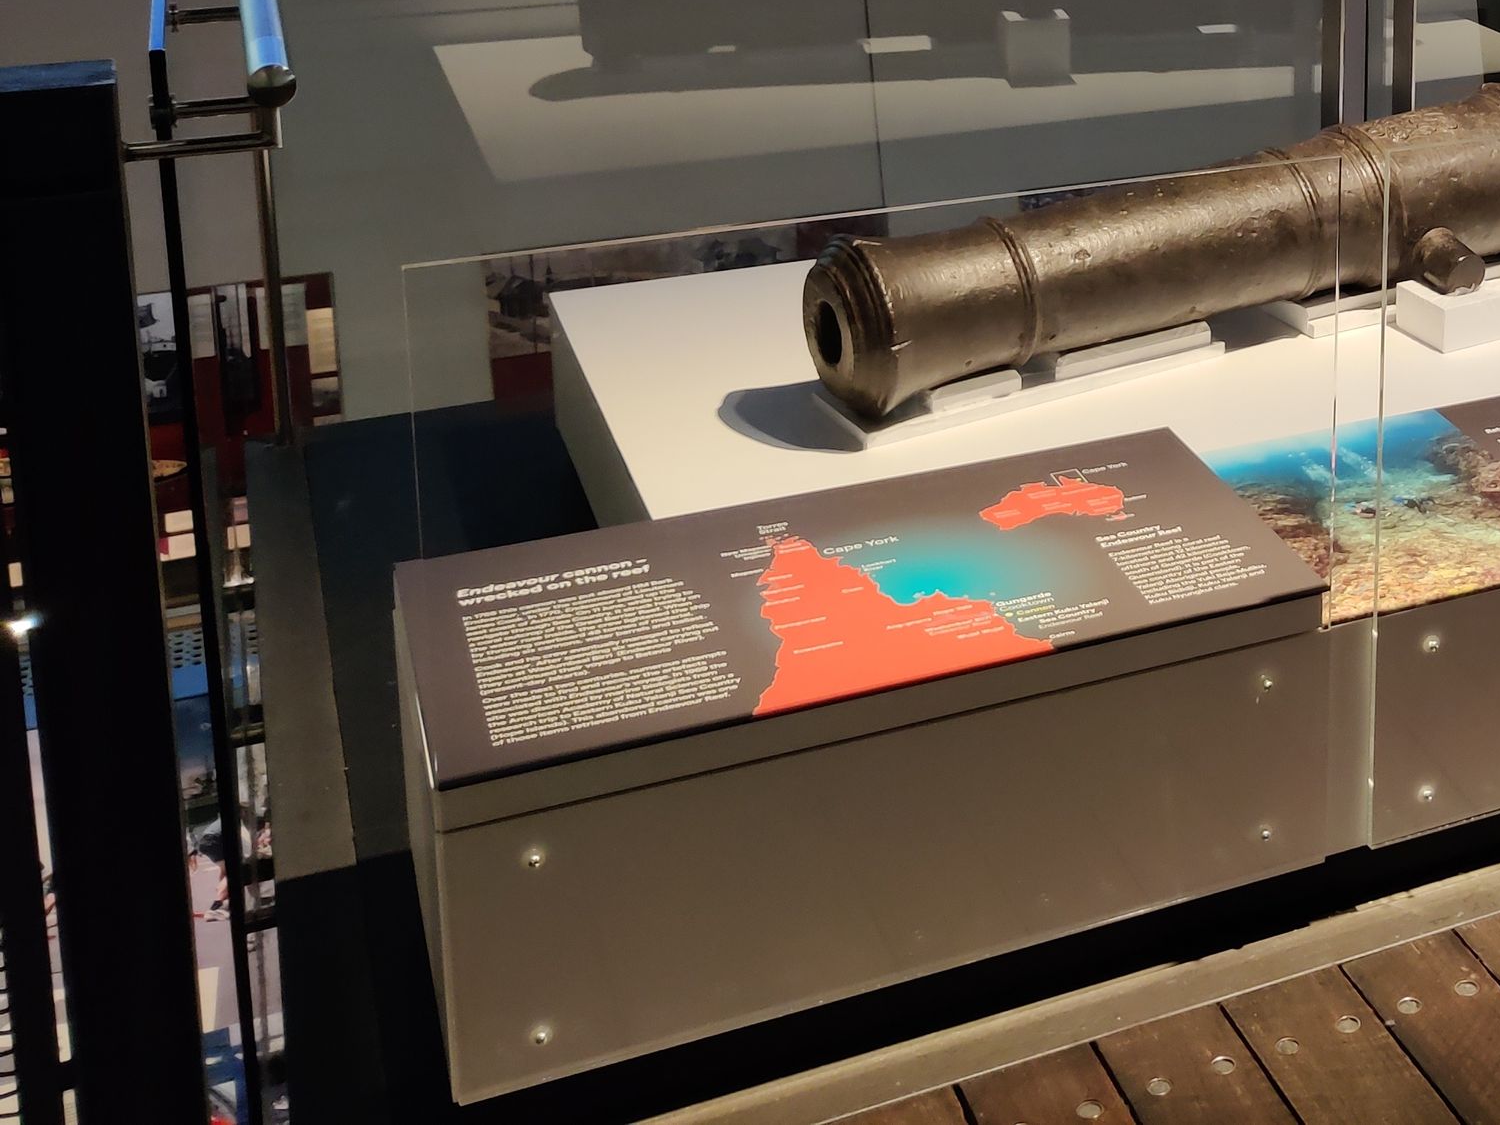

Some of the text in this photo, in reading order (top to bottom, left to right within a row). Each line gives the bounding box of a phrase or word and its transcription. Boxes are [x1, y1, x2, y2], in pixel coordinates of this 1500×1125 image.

[1081, 461, 1128, 475] Cape York
[756, 521, 789, 531] Torres
[759, 526, 787, 535] Strait
[1095, 525, 1160, 542] Sea Country
[1100, 526, 1182, 548] Endeavour Reef
[823, 543, 862, 555] Cape
[864, 536, 899, 547] York
[456, 574, 558, 598] Endeavour
[562, 560, 632, 578] cannon
[458, 564, 650, 606] wrecked on the reef
[995, 592, 1051, 607] Gungarde
[999, 597, 1054, 612] Cooktown
[1015, 604, 1055, 615] Cannon
[1017, 598, 1109, 623] Eastern Kuku Yalanji
[1057, 608, 1095, 619] Country
[1038, 611, 1103, 629] Endeavour Reef
[1048, 630, 1075, 640] Cairns
